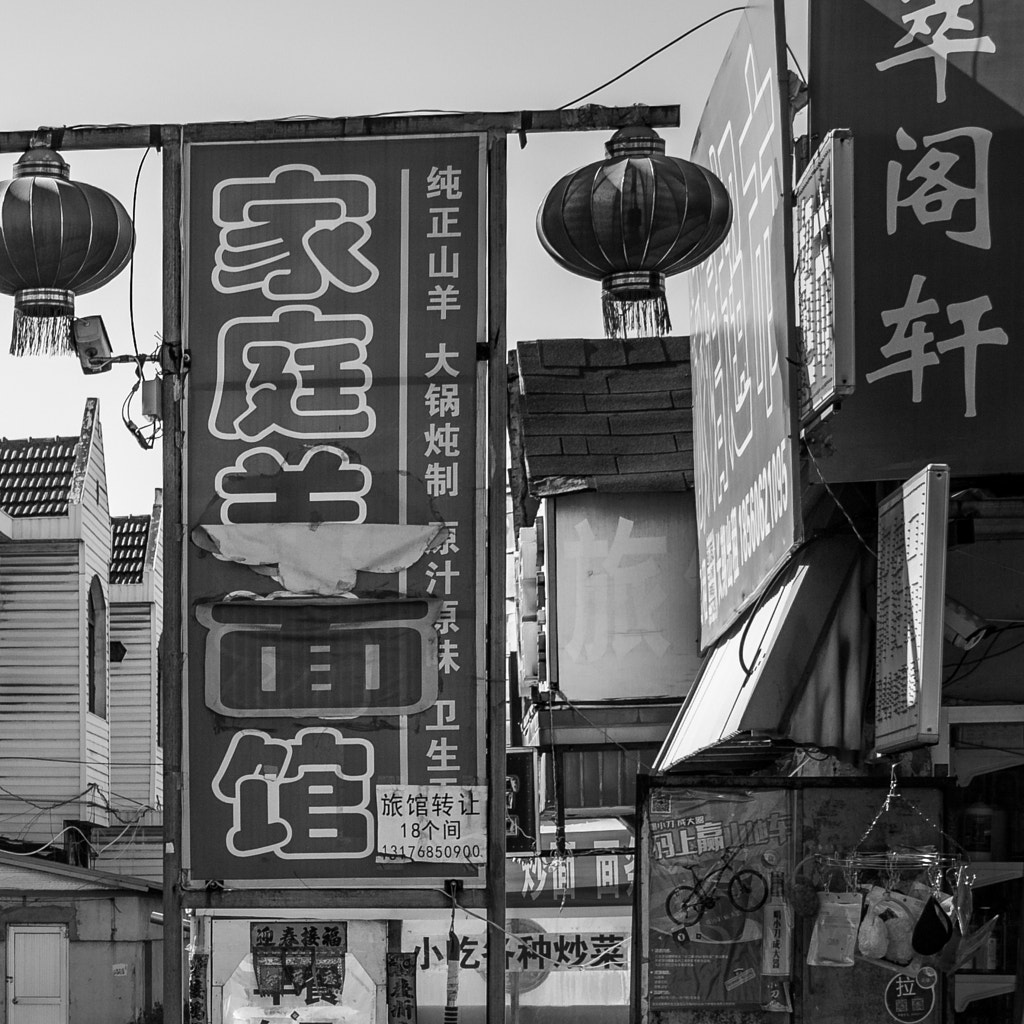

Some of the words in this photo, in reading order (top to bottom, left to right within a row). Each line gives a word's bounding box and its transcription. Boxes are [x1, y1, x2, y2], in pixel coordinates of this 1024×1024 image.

[425, 165, 463, 320] 纯正山羊
[424, 342, 461, 498] 大锅炖制
[738, 437, 789, 567] 18560621095
[424, 699, 462, 787] 卫生
[381, 793, 480, 817] 旅馆转让
[400, 820, 461, 840] 18个间
[382, 844, 480, 860] 13176850900
[255, 925, 343, 948] 迎春接福
